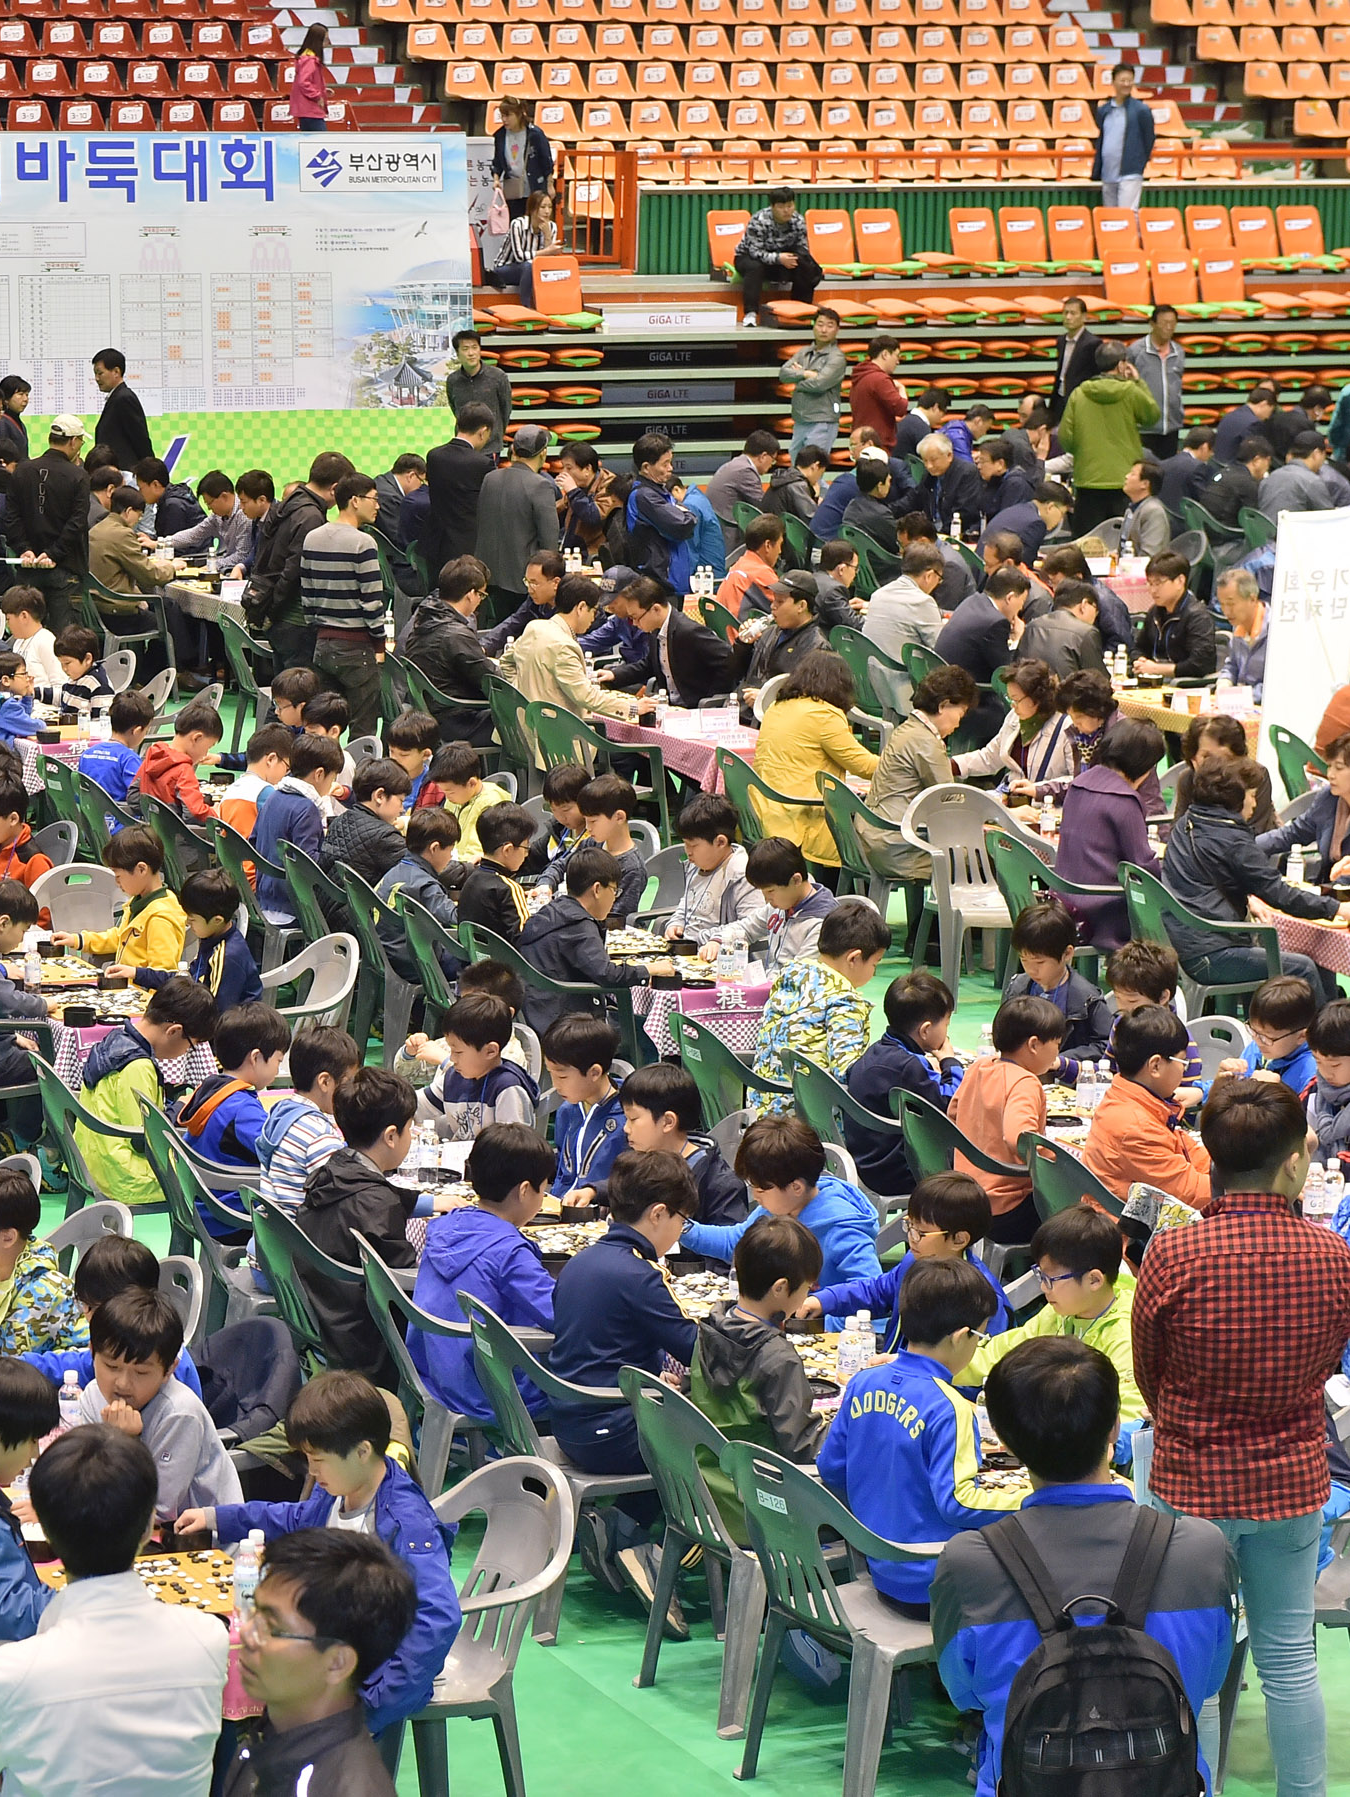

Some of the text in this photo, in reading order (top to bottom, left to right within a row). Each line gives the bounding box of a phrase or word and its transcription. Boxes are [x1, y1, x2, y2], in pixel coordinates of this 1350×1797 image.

[2, 31, 20, 39] 5-10
[52, 32, 70, 40] 5-11
[102, 32, 120, 40] 5-12
[151, 32, 169, 40] 5-13
[201, 32, 219, 40] 5-14
[86, 71, 104, 79] 4-11
[136, 72, 154, 80] 4-12
[236, 72, 254, 80] 4-14
[22, 112, 34, 120] 3-9
[70, 111, 88, 119] 3-10
[174, 111, 189, 119] 3-12
[222, 110, 240, 118] 3-13
[349, 153, 436, 172] 부산광역시
[648, 315, 690, 325] GiGA LTE
[649, 352, 691, 361] GiGA LTE
[647, 389, 689, 399] GiGA LTE
[671, 425, 687, 434] LTE
[674, 460, 686, 469] TE
[716, 986, 748, 1010] 棋
[850, 1389, 925, 1440] DODGERS
[758, 1490, 786, 1511] B-126
